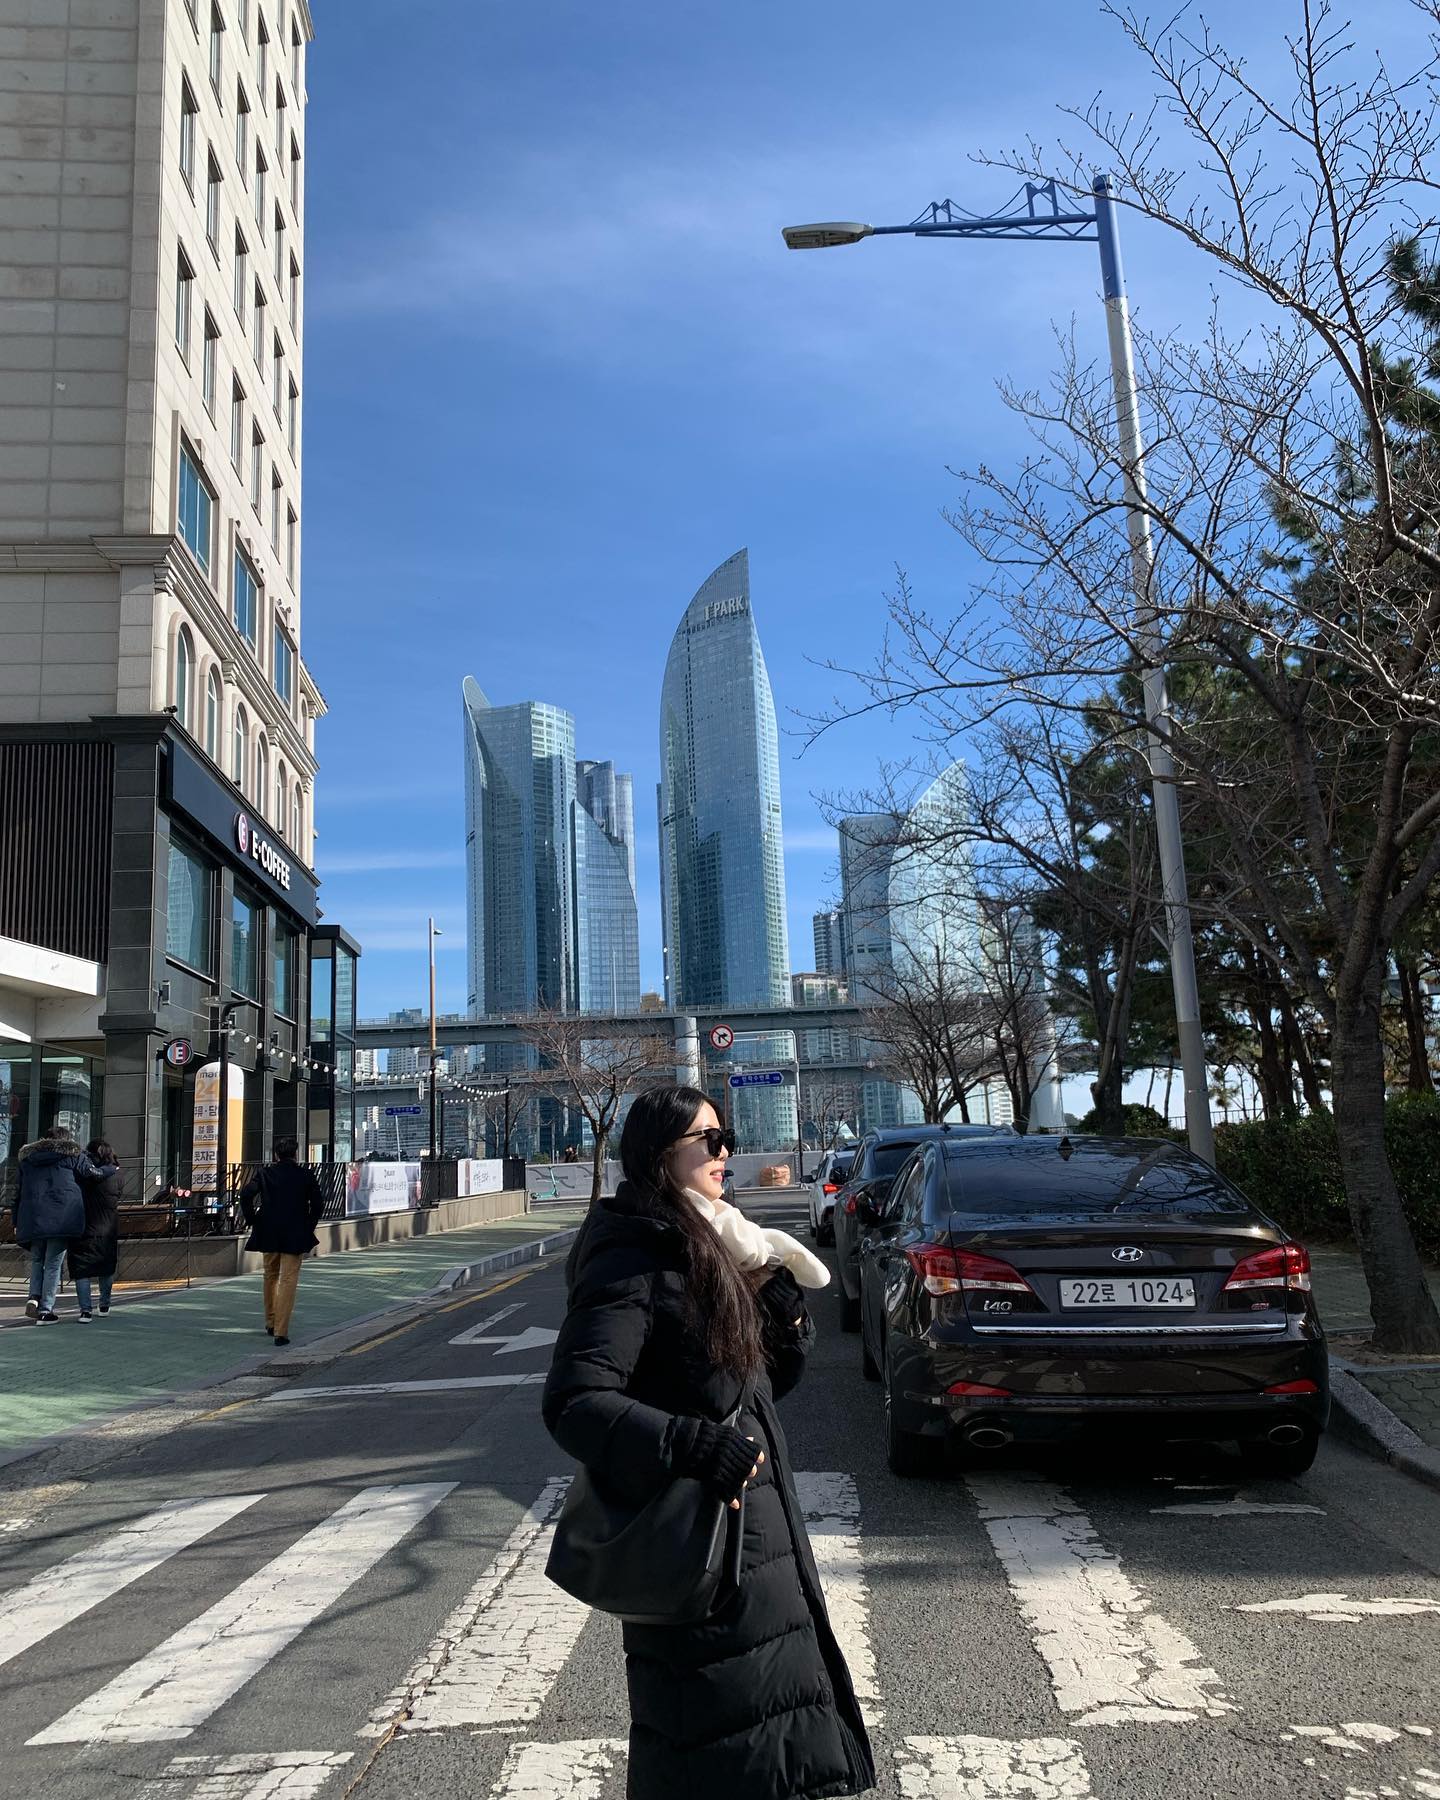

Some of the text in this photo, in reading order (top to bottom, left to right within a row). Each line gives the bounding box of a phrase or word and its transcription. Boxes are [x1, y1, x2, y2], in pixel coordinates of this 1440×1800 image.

[175, 1046, 184, 1060] E
[1072, 1281, 1184, 1304] 22로 1024
